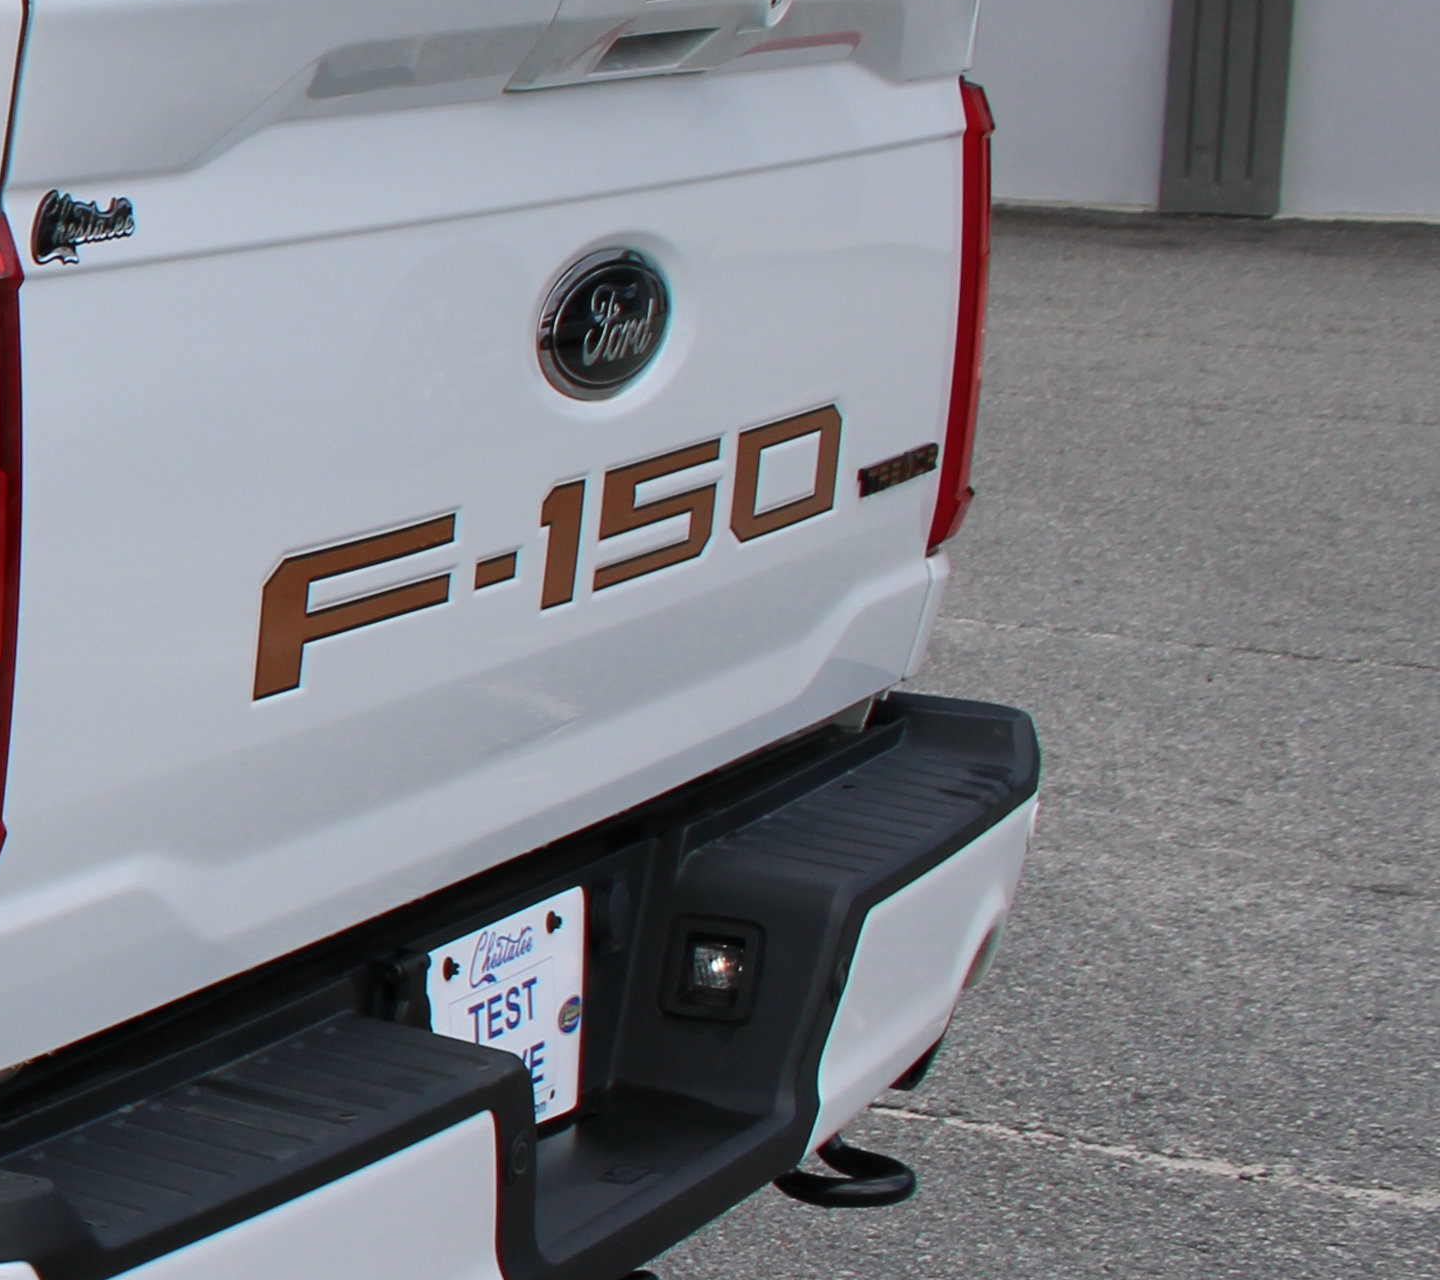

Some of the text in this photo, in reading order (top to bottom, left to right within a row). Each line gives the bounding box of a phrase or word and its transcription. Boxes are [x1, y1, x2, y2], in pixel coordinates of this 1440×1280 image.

[582, 282, 658, 367] Ford
[252, 402, 843, 702] F-150
[468, 976, 538, 1045] TEST
